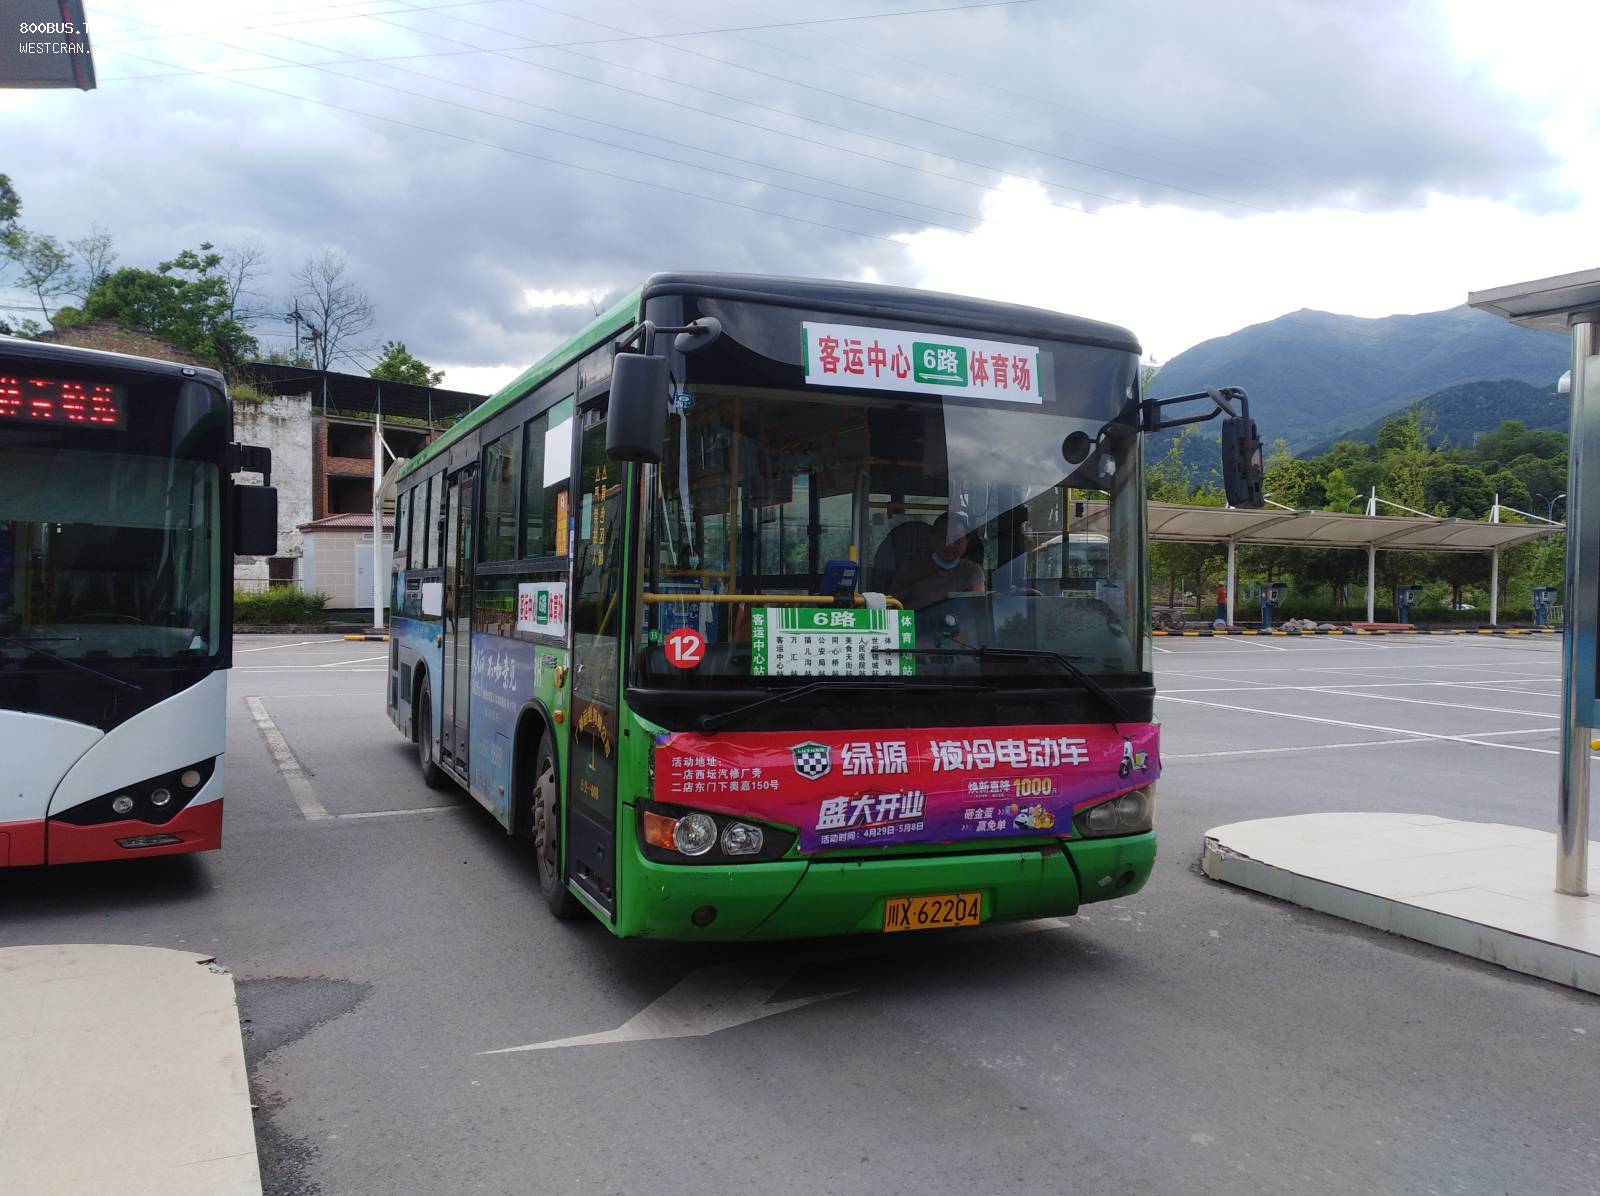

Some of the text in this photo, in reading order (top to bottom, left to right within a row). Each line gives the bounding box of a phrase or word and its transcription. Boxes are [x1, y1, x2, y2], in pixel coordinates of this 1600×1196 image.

[818, 335, 1031, 392] 客运中心 6路 体育场
[813, 611, 856, 628] 6路
[669, 635, 700, 661] 12
[752, 613, 765, 676] 客运中心站
[840, 737, 1090, 776] 绿源 液冷电动车
[815, 790, 925, 831] 盛大开业
